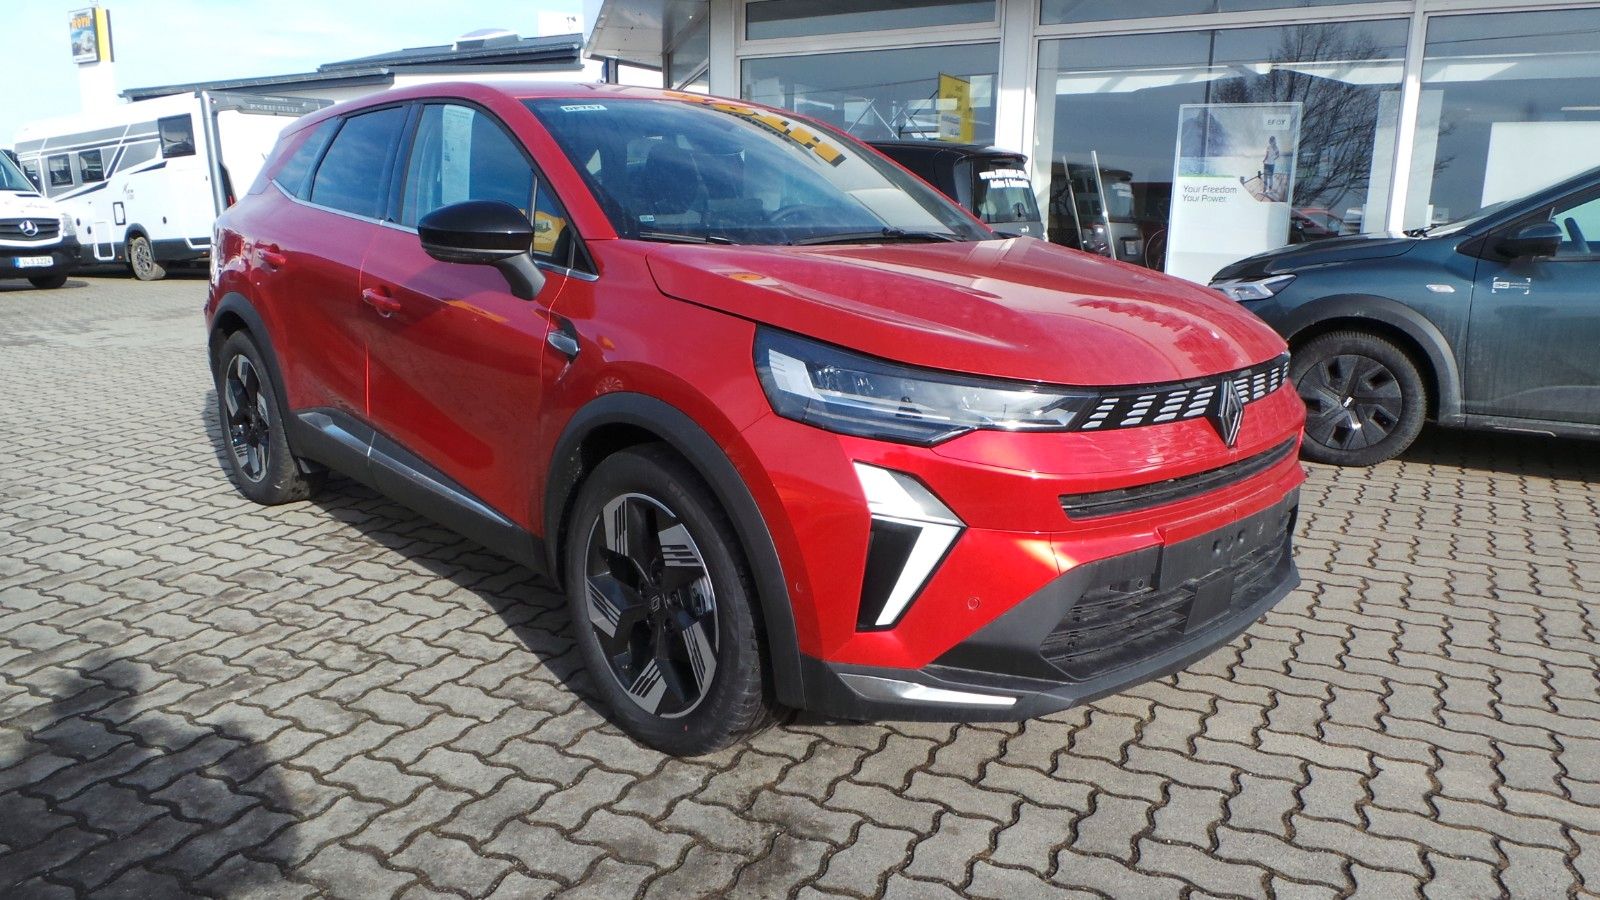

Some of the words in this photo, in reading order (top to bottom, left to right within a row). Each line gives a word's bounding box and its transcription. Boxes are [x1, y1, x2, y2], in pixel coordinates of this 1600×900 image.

[1183, 185, 1200, 193] Your
[1202, 185, 1237, 194] Freedom
[1182, 194, 1200, 202] Your
[1201, 194, 1226, 202] Power
